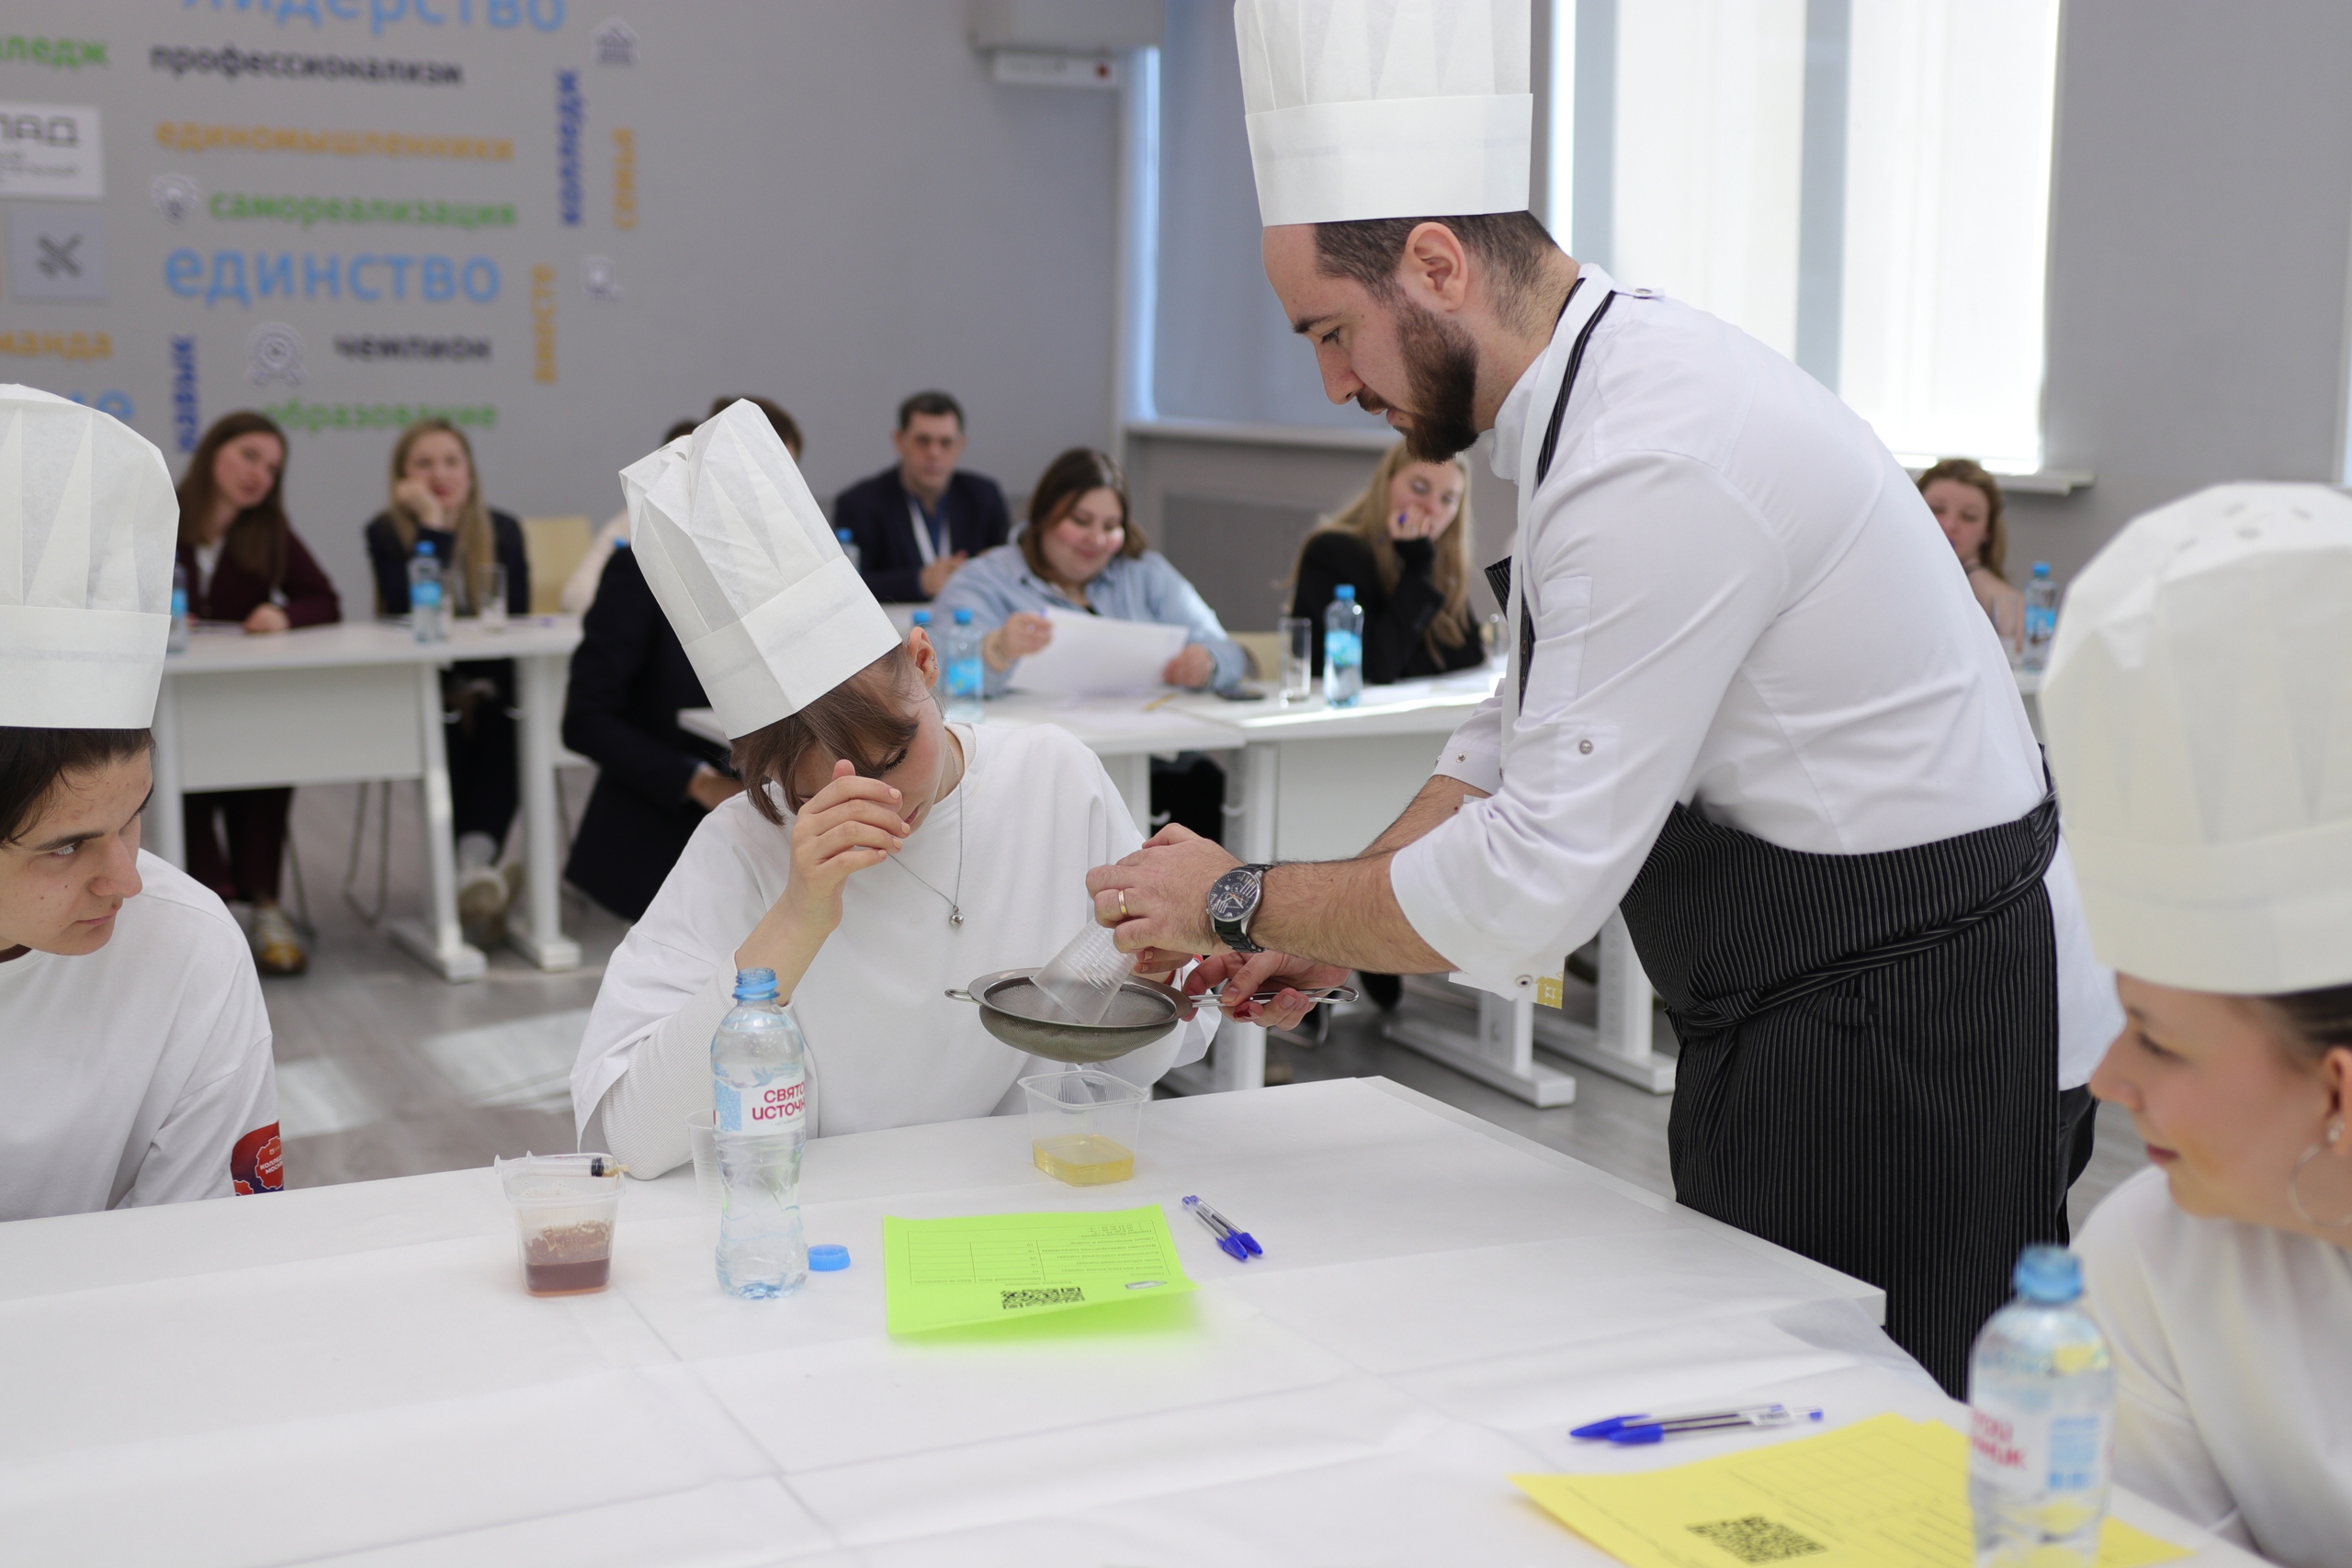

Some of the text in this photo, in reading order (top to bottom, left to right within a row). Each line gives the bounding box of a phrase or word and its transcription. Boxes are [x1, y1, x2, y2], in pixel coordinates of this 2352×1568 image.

[0, 36, 108, 71] ледж
[149, 44, 463, 86] профессионализм
[155, 121, 514, 161] единомышленники
[209, 192, 517, 229] самореализация
[164, 248, 502, 309] единство
[334, 336, 491, 362] чемпион
[763, 1081, 805, 1103] СВЯТО
